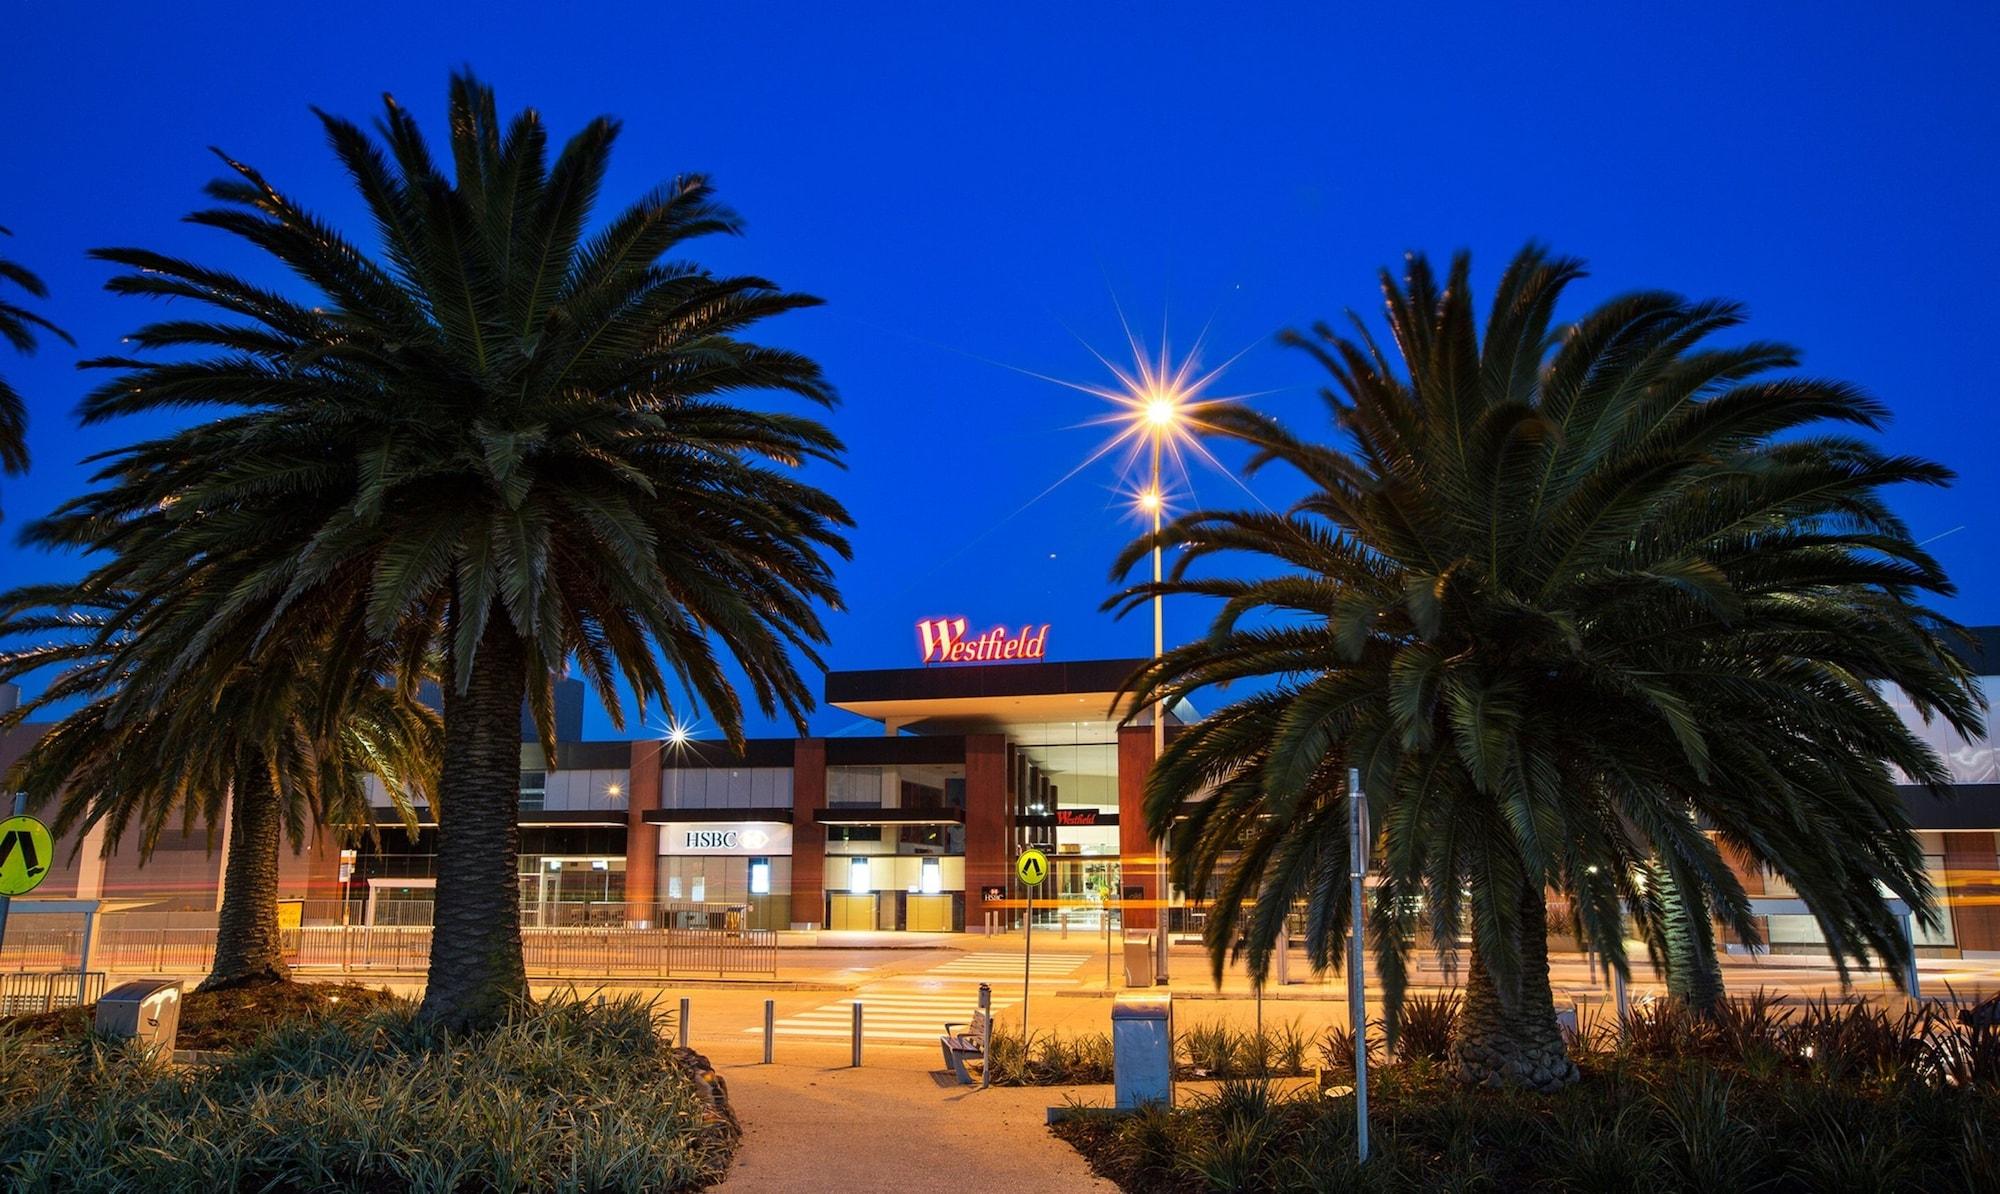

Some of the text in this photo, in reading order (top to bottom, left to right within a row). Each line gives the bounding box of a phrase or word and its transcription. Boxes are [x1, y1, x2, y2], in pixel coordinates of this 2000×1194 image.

[916, 617, 1050, 662] Westfield
[1056, 810, 1097, 825] Westfield
[686, 831, 737, 849] HSBC
